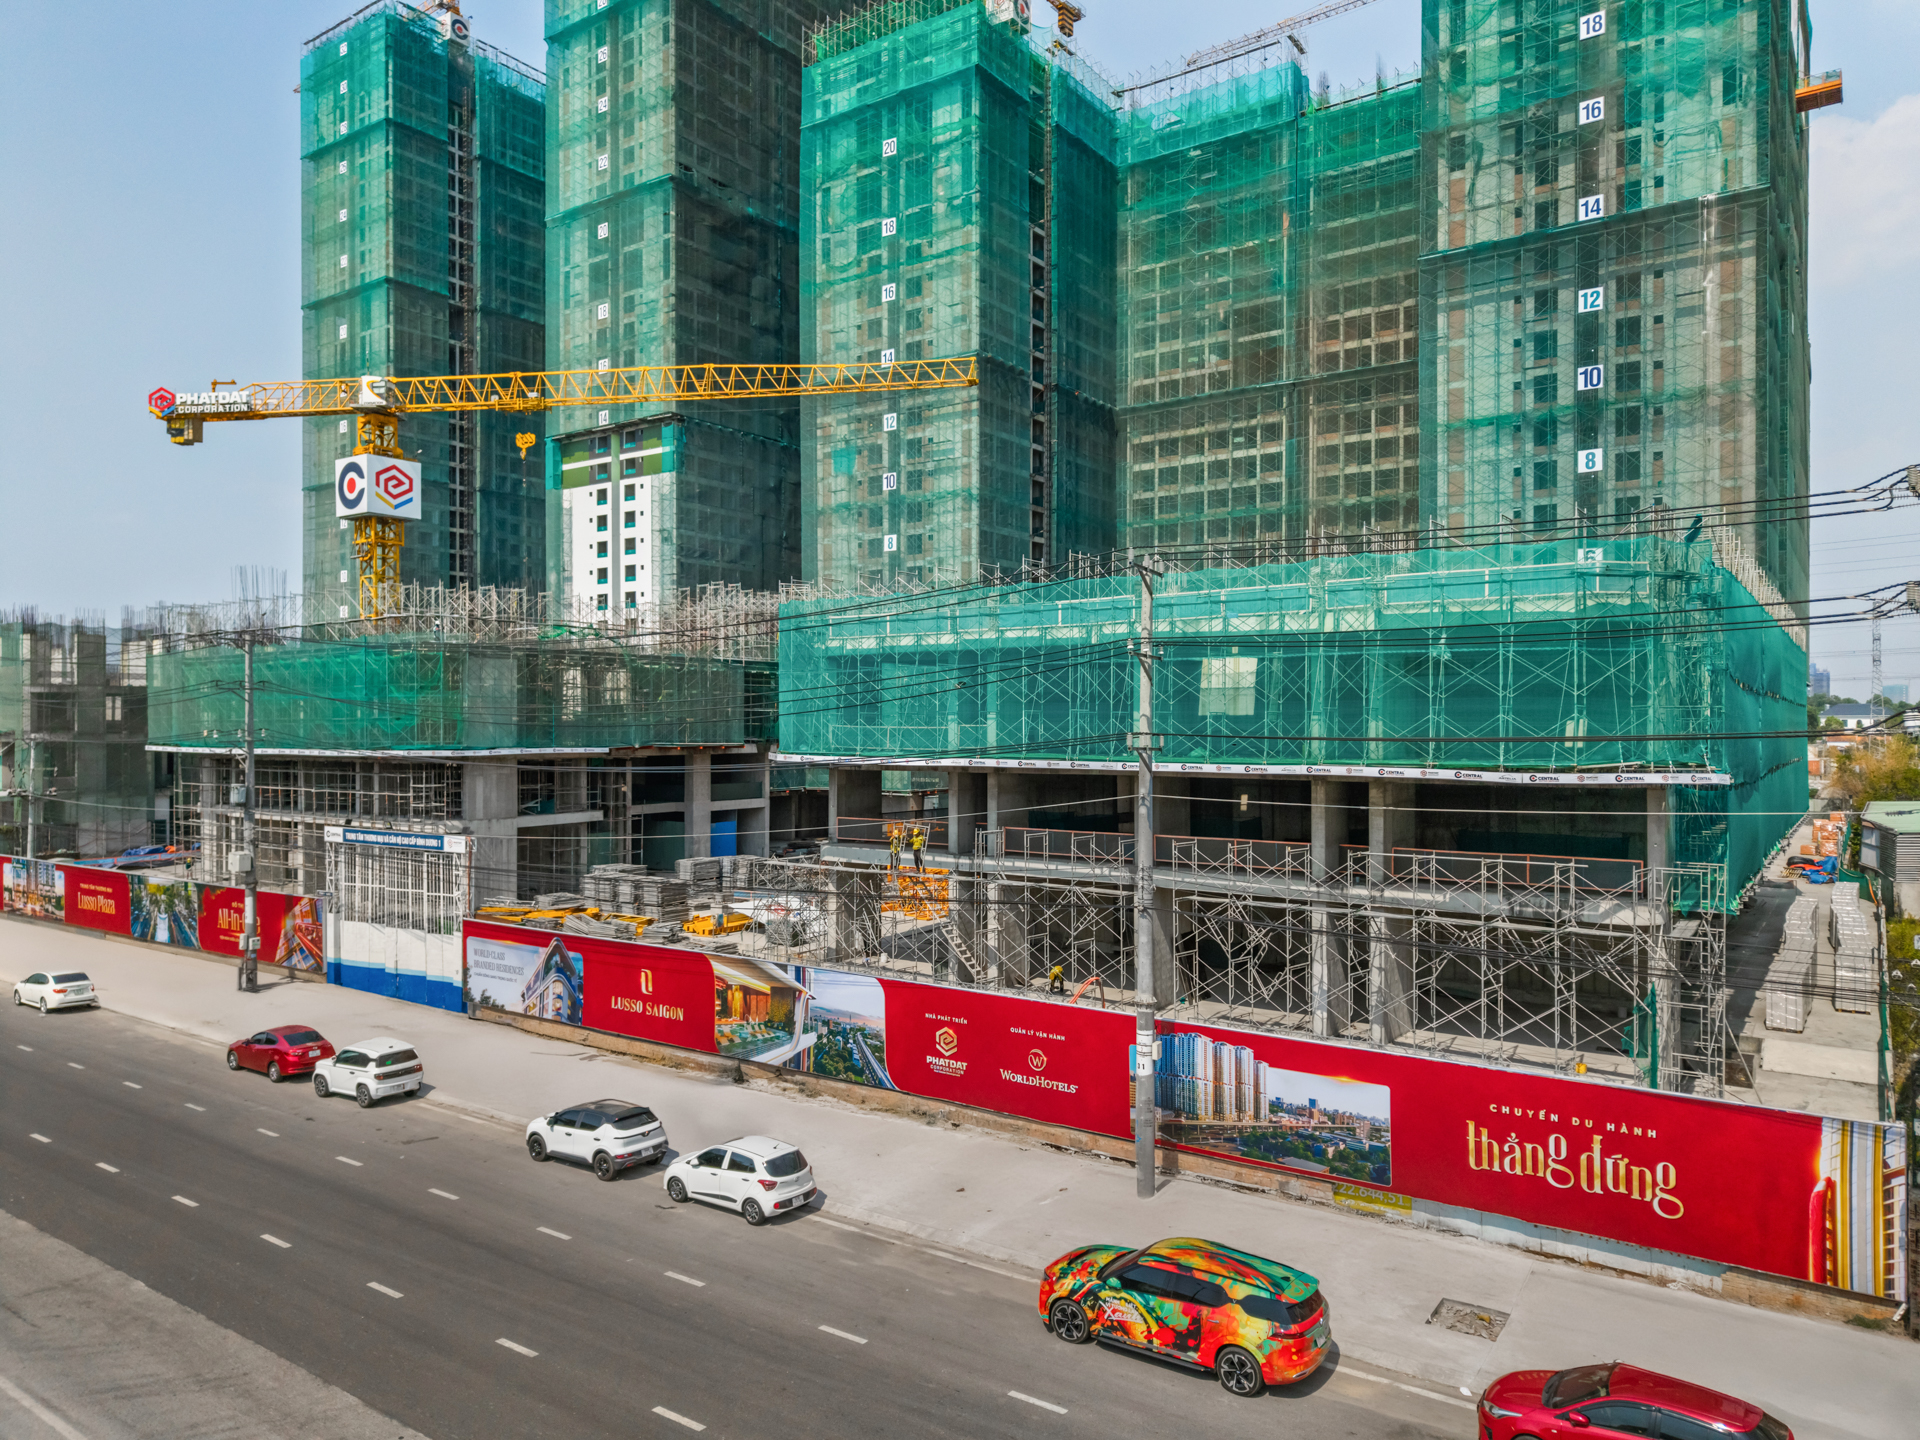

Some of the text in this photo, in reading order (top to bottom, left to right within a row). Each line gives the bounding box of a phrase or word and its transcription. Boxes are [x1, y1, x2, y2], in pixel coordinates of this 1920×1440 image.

[1582, 14, 1602, 35] 18
[599, 48, 607, 62] 26
[598, 98, 607, 112] 24
[1582, 100, 1602, 121] 16
[884, 139, 896, 155] 20
[599, 156, 607, 169] 22
[1581, 197, 1602, 218] 14
[599, 224, 607, 237] 20
[884, 219, 895, 234] 18
[883, 285, 894, 300] 16
[1580, 290, 1601, 310] 12
[599, 305, 607, 318] 18
[883, 351, 893, 363] 14
[1579, 366, 1602, 388] 10
[175, 391, 250, 405] PHATDAT
[178, 404, 248, 414] CORPORATION
[600, 411, 608, 424] 14
[885, 415, 895, 429] 12
[1585, 451, 1596, 470] 8
[884, 474, 895, 489] 10
[887, 537, 894, 550] 8
[78, 892, 116, 915] Lusso Plaza
[217, 908, 261, 935] All-In-Oe
[473, 948, 506, 961] WORLD-CLASS
[473, 959, 525, 976] BRANDED RESIDENCES
[611, 995, 684, 1021] LUSSO SAIGON
[937, 1014, 951, 1022] PHÁT
[1010, 1027, 1026, 1035] QUẢN
[1035, 1030, 1047, 1039] VẬN
[1048, 1033, 1065, 1041] HÀNH
[926, 1055, 968, 1070] PHATDAT
[930, 1064, 964, 1075] CORPORATION
[1489, 1104, 1657, 1138] CHUYẾN DU HÀNH
[1466, 1120, 1685, 1219] thẳng đứng
